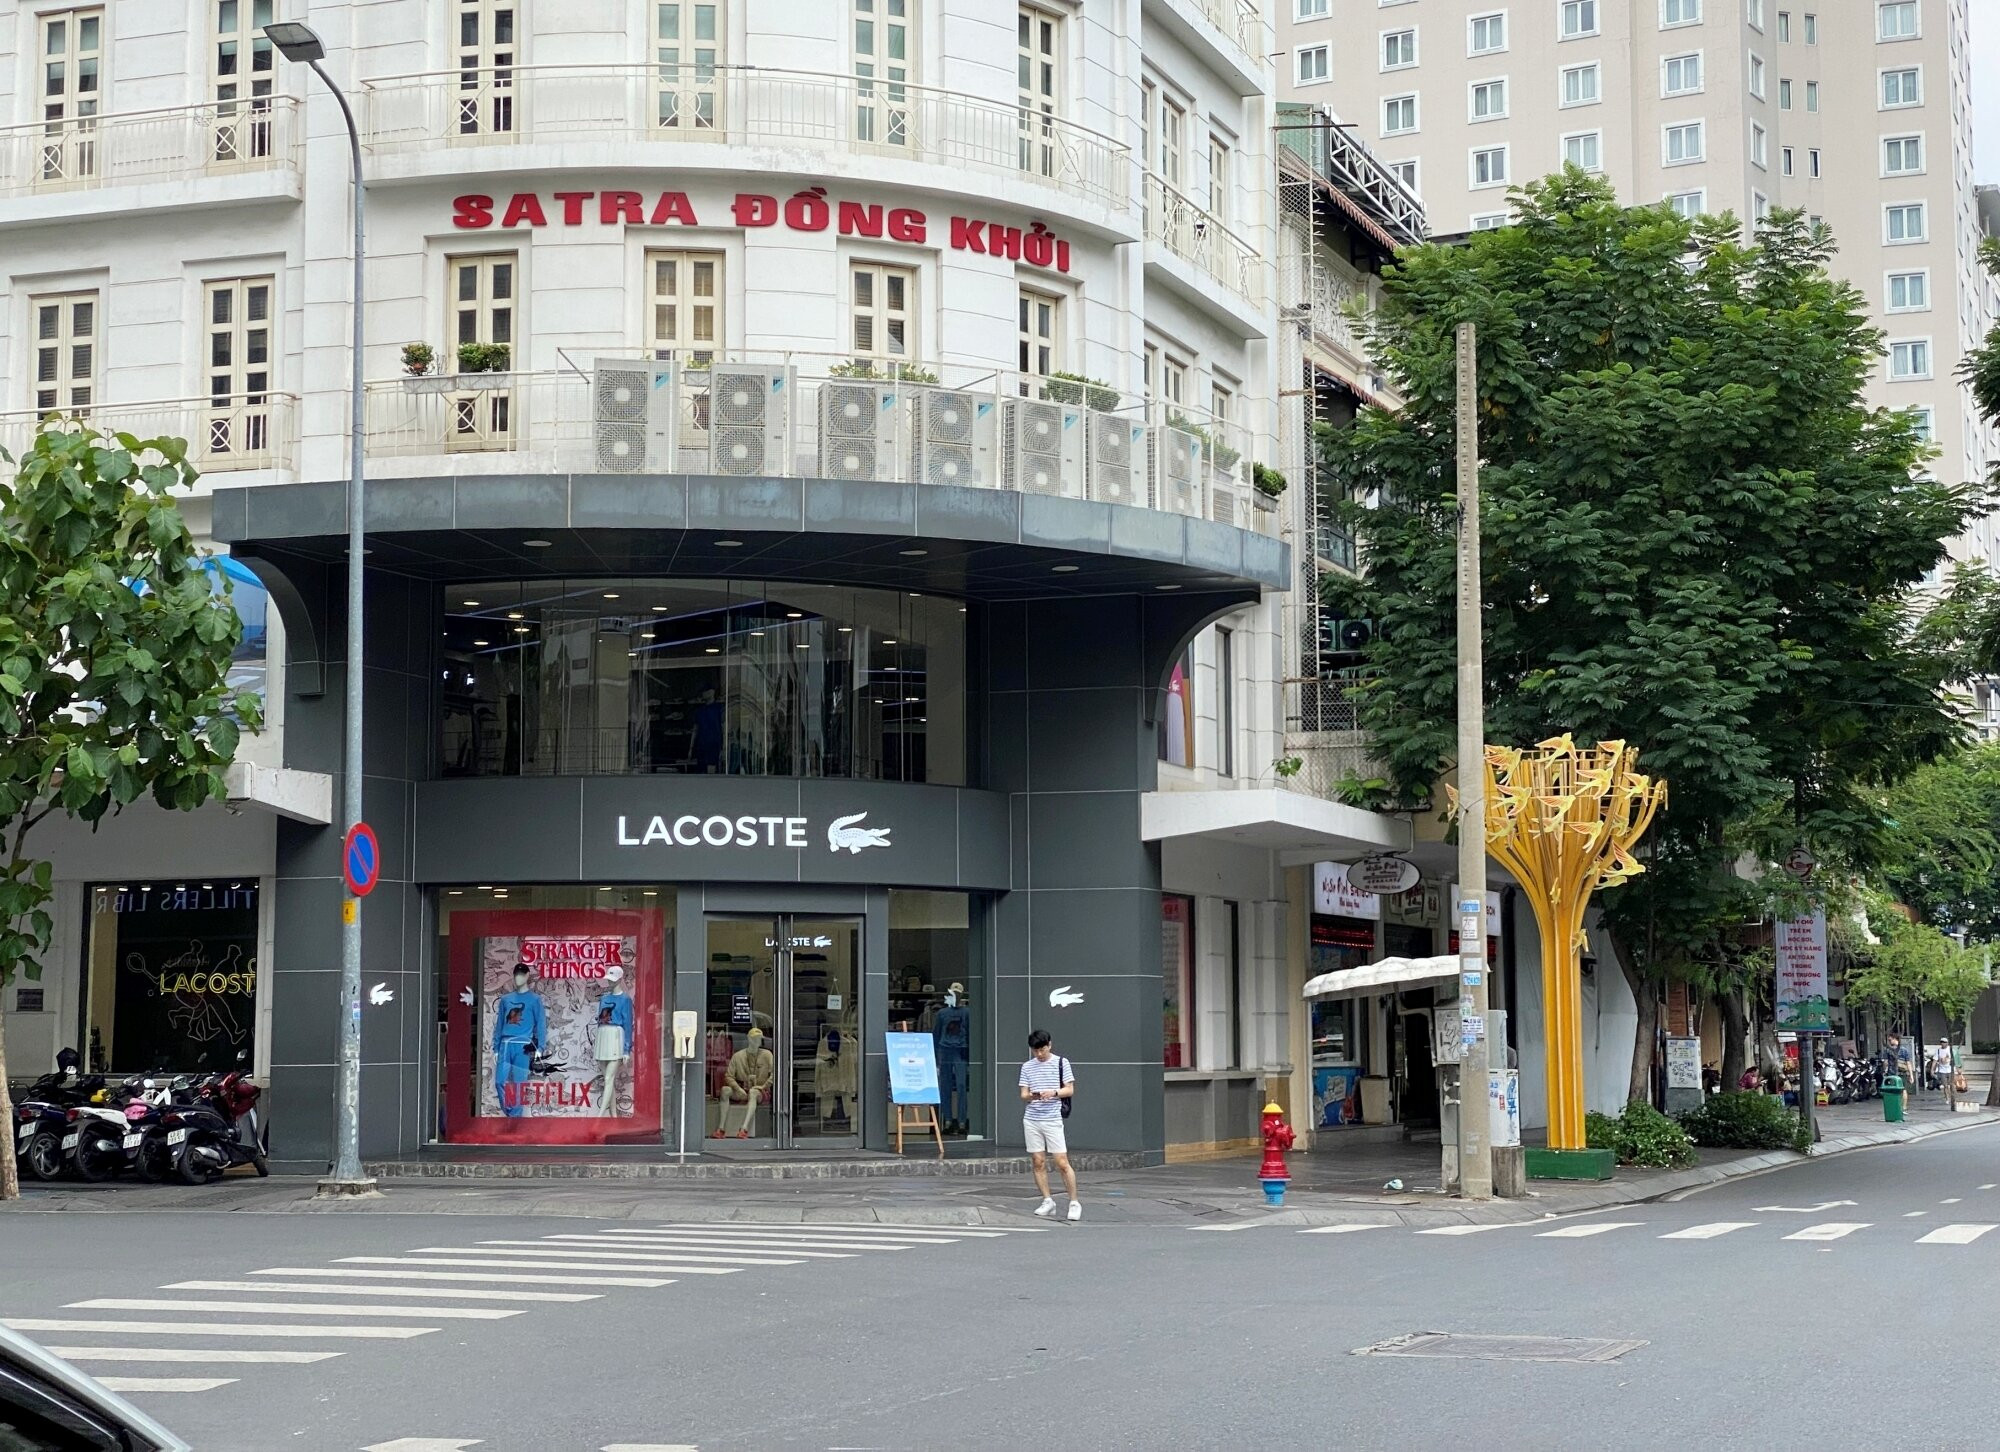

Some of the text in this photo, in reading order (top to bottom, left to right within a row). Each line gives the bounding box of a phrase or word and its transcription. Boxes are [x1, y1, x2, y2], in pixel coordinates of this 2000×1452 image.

[452, 186, 1070, 272] SATRA ĐỒNG KHỞI
[618, 815, 808, 847] LACOSTE
[521, 941, 623, 966] STRANGER
[537, 961, 607, 980] THINGS
[503, 1082, 592, 1108] NETFLIX
